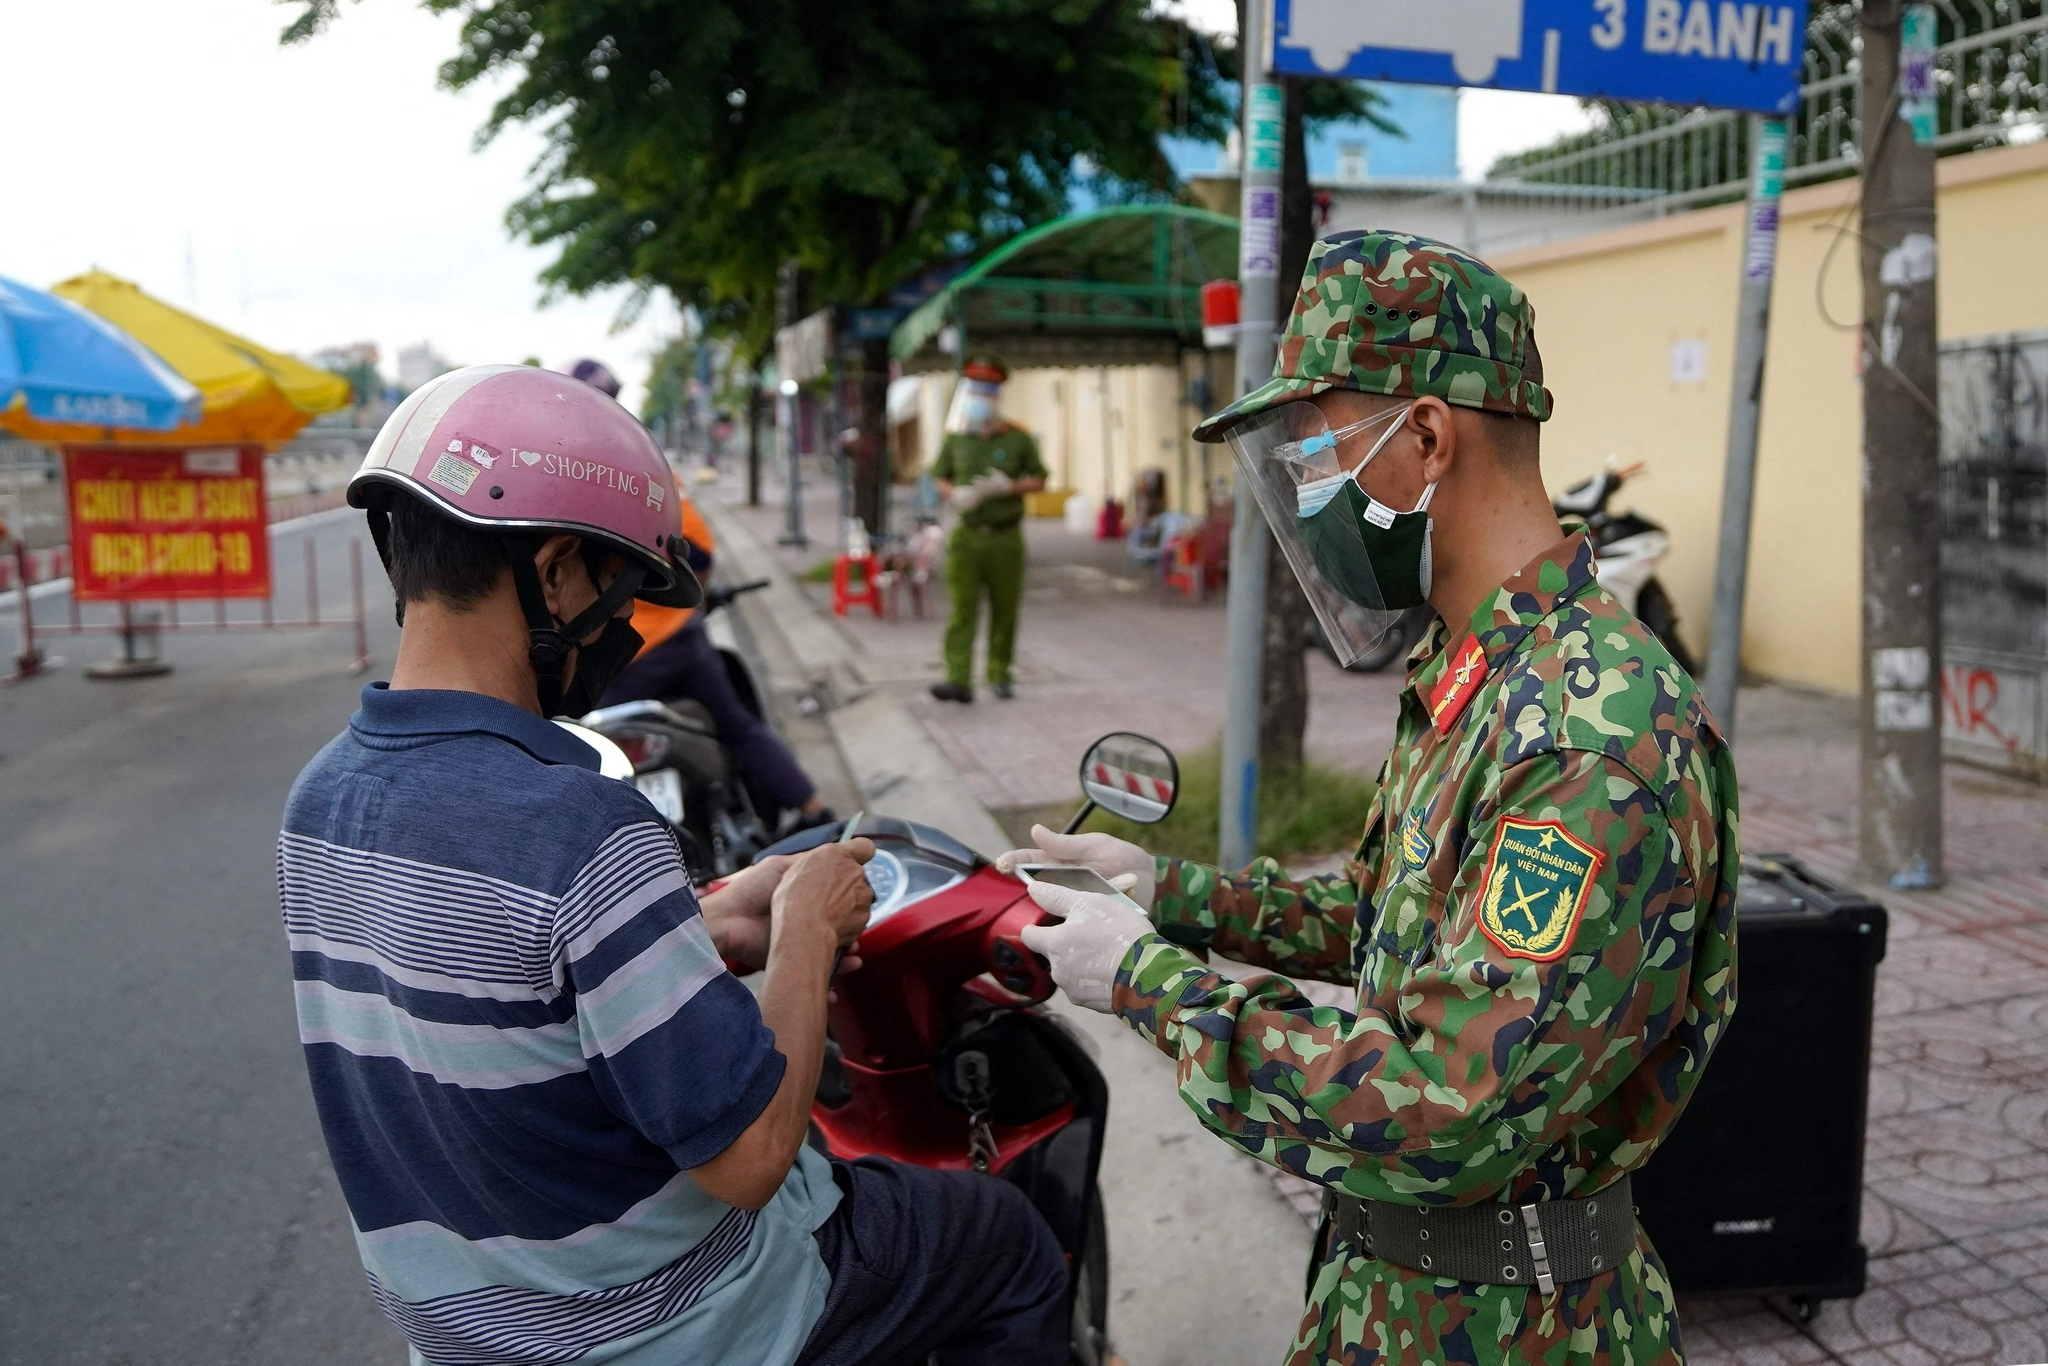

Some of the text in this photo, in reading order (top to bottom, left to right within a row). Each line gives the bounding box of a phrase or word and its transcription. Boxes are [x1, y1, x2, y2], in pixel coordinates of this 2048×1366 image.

[1591, 0, 1627, 49] 3
[510, 448, 639, 496] I SHOPPING
[150, 531, 251, 577] COVID-19
[1504, 838, 1585, 877] QUÂN ĐỘI NHÂN DÂN
[1517, 859, 1560, 882] VIỆT NAM
